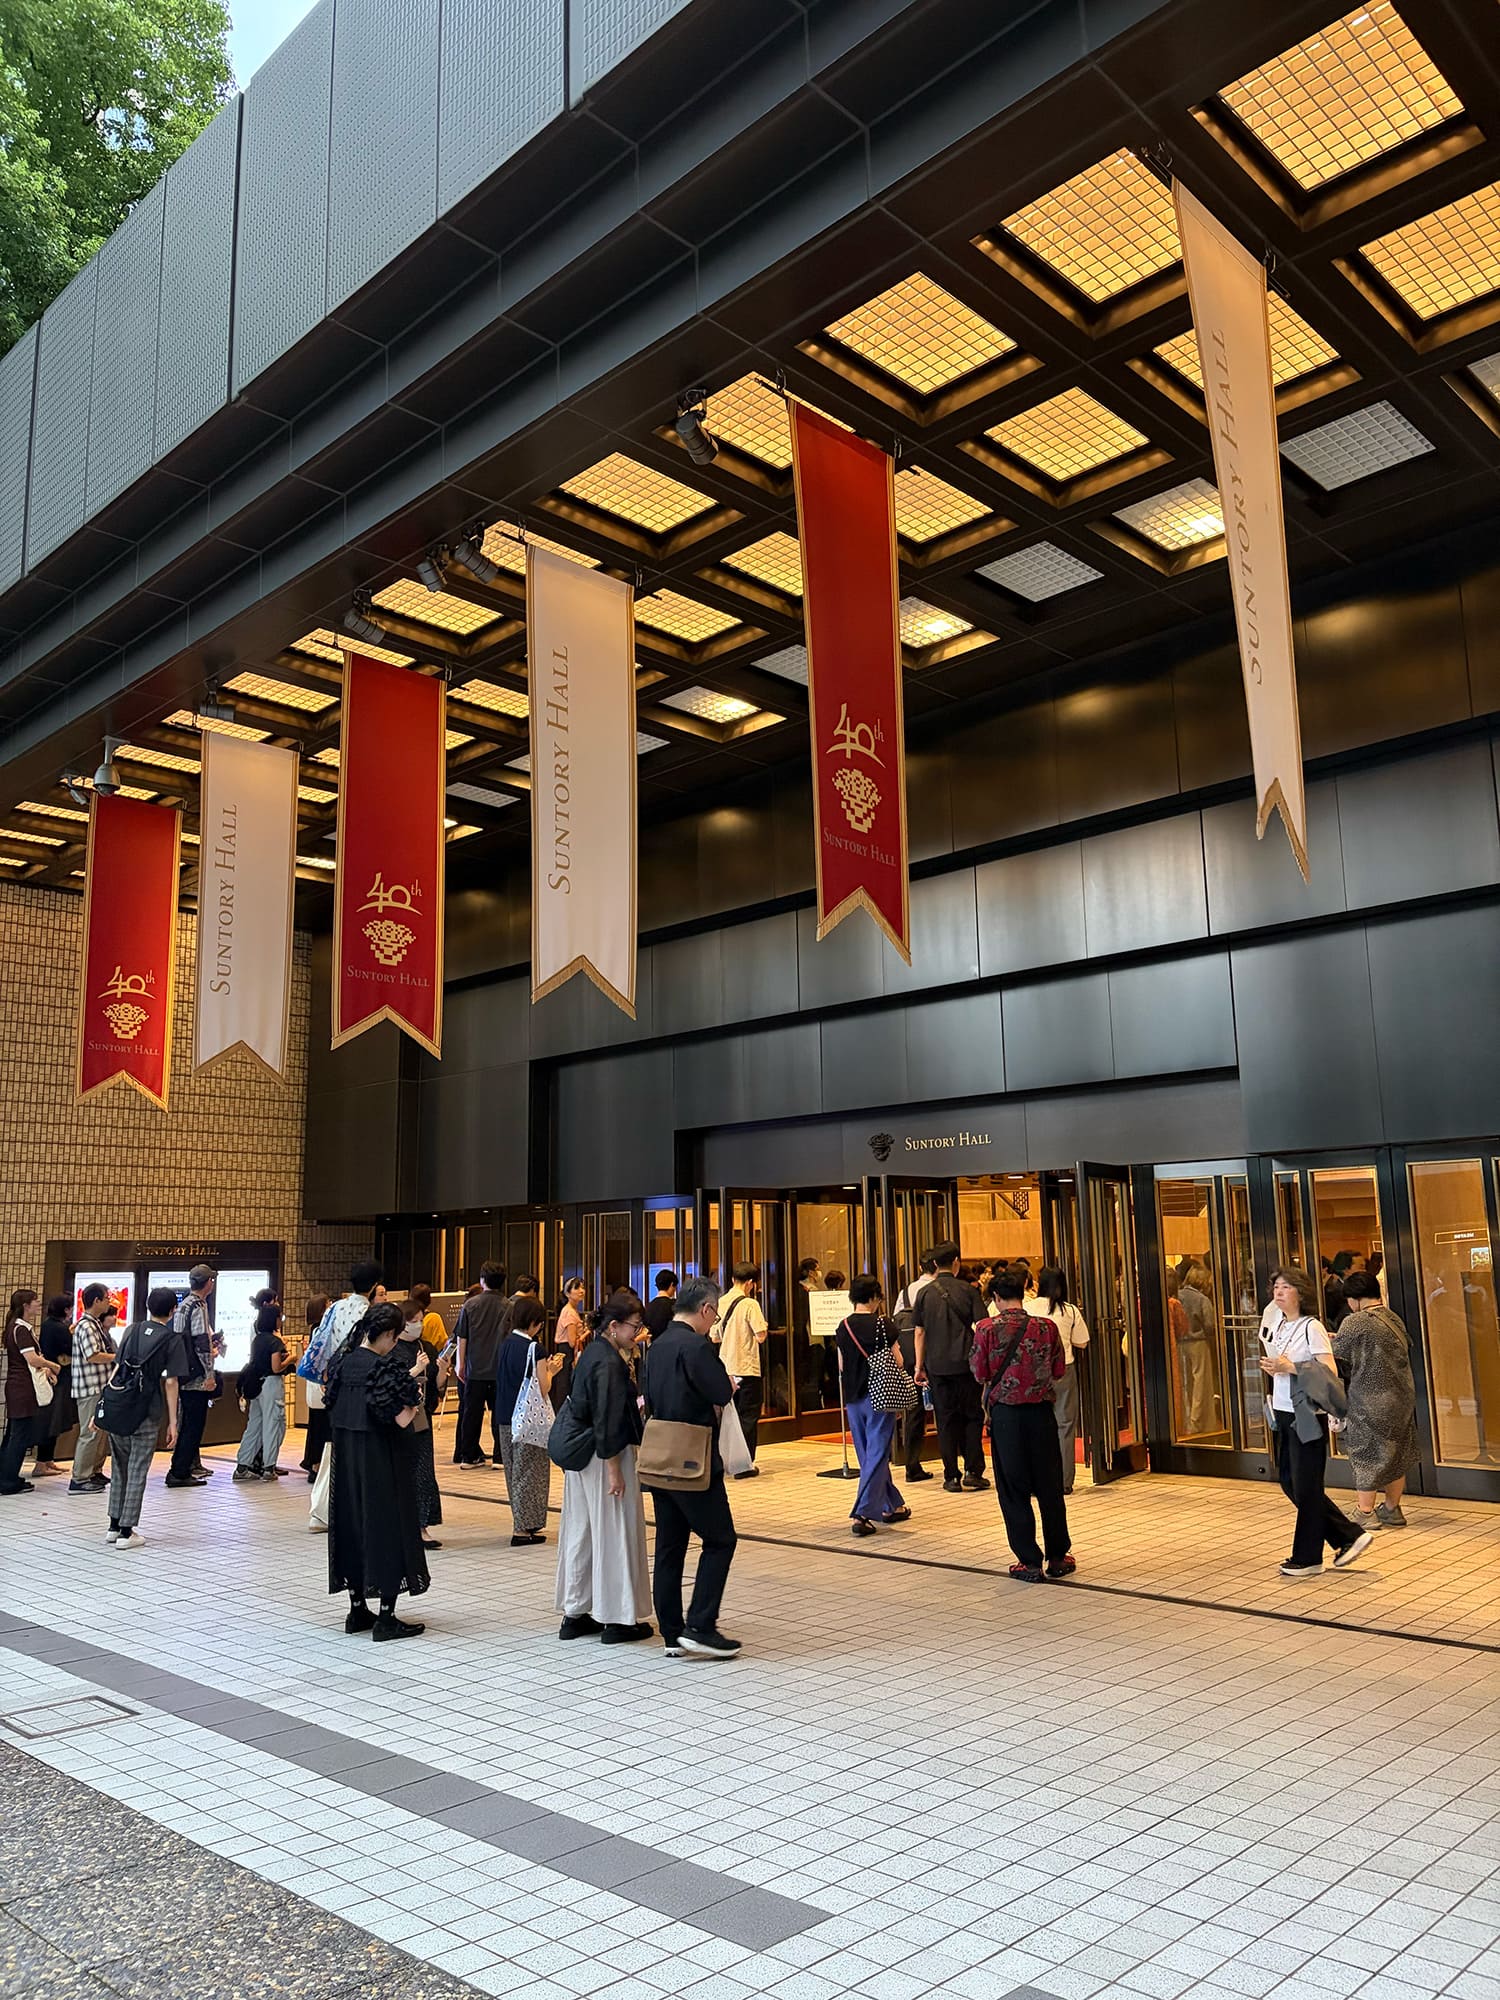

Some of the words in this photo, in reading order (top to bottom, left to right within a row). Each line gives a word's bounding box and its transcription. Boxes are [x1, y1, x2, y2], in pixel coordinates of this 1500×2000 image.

[1210, 328, 1239, 454] HALL
[546, 645, 570, 735] HALL
[214, 804, 238, 872] HALL
[547, 741, 571, 895] SUNTORY
[823, 827, 868, 857] SUNTORY
[871, 844, 897, 867] HALL
[209, 879, 235, 996] SUNTORY
[346, 964, 396, 984] SUNTORY
[400, 972, 430, 987] HALL
[87, 1040, 132, 1054] SUNTORY
[135, 1044, 160, 1056] HALL
[904, 1136, 956, 1151] SUNTORY
[959, 1131, 992, 1146] HALL
[135, 1243, 187, 1256] SUNTORY
[188, 1243, 220, 1256] HALL
